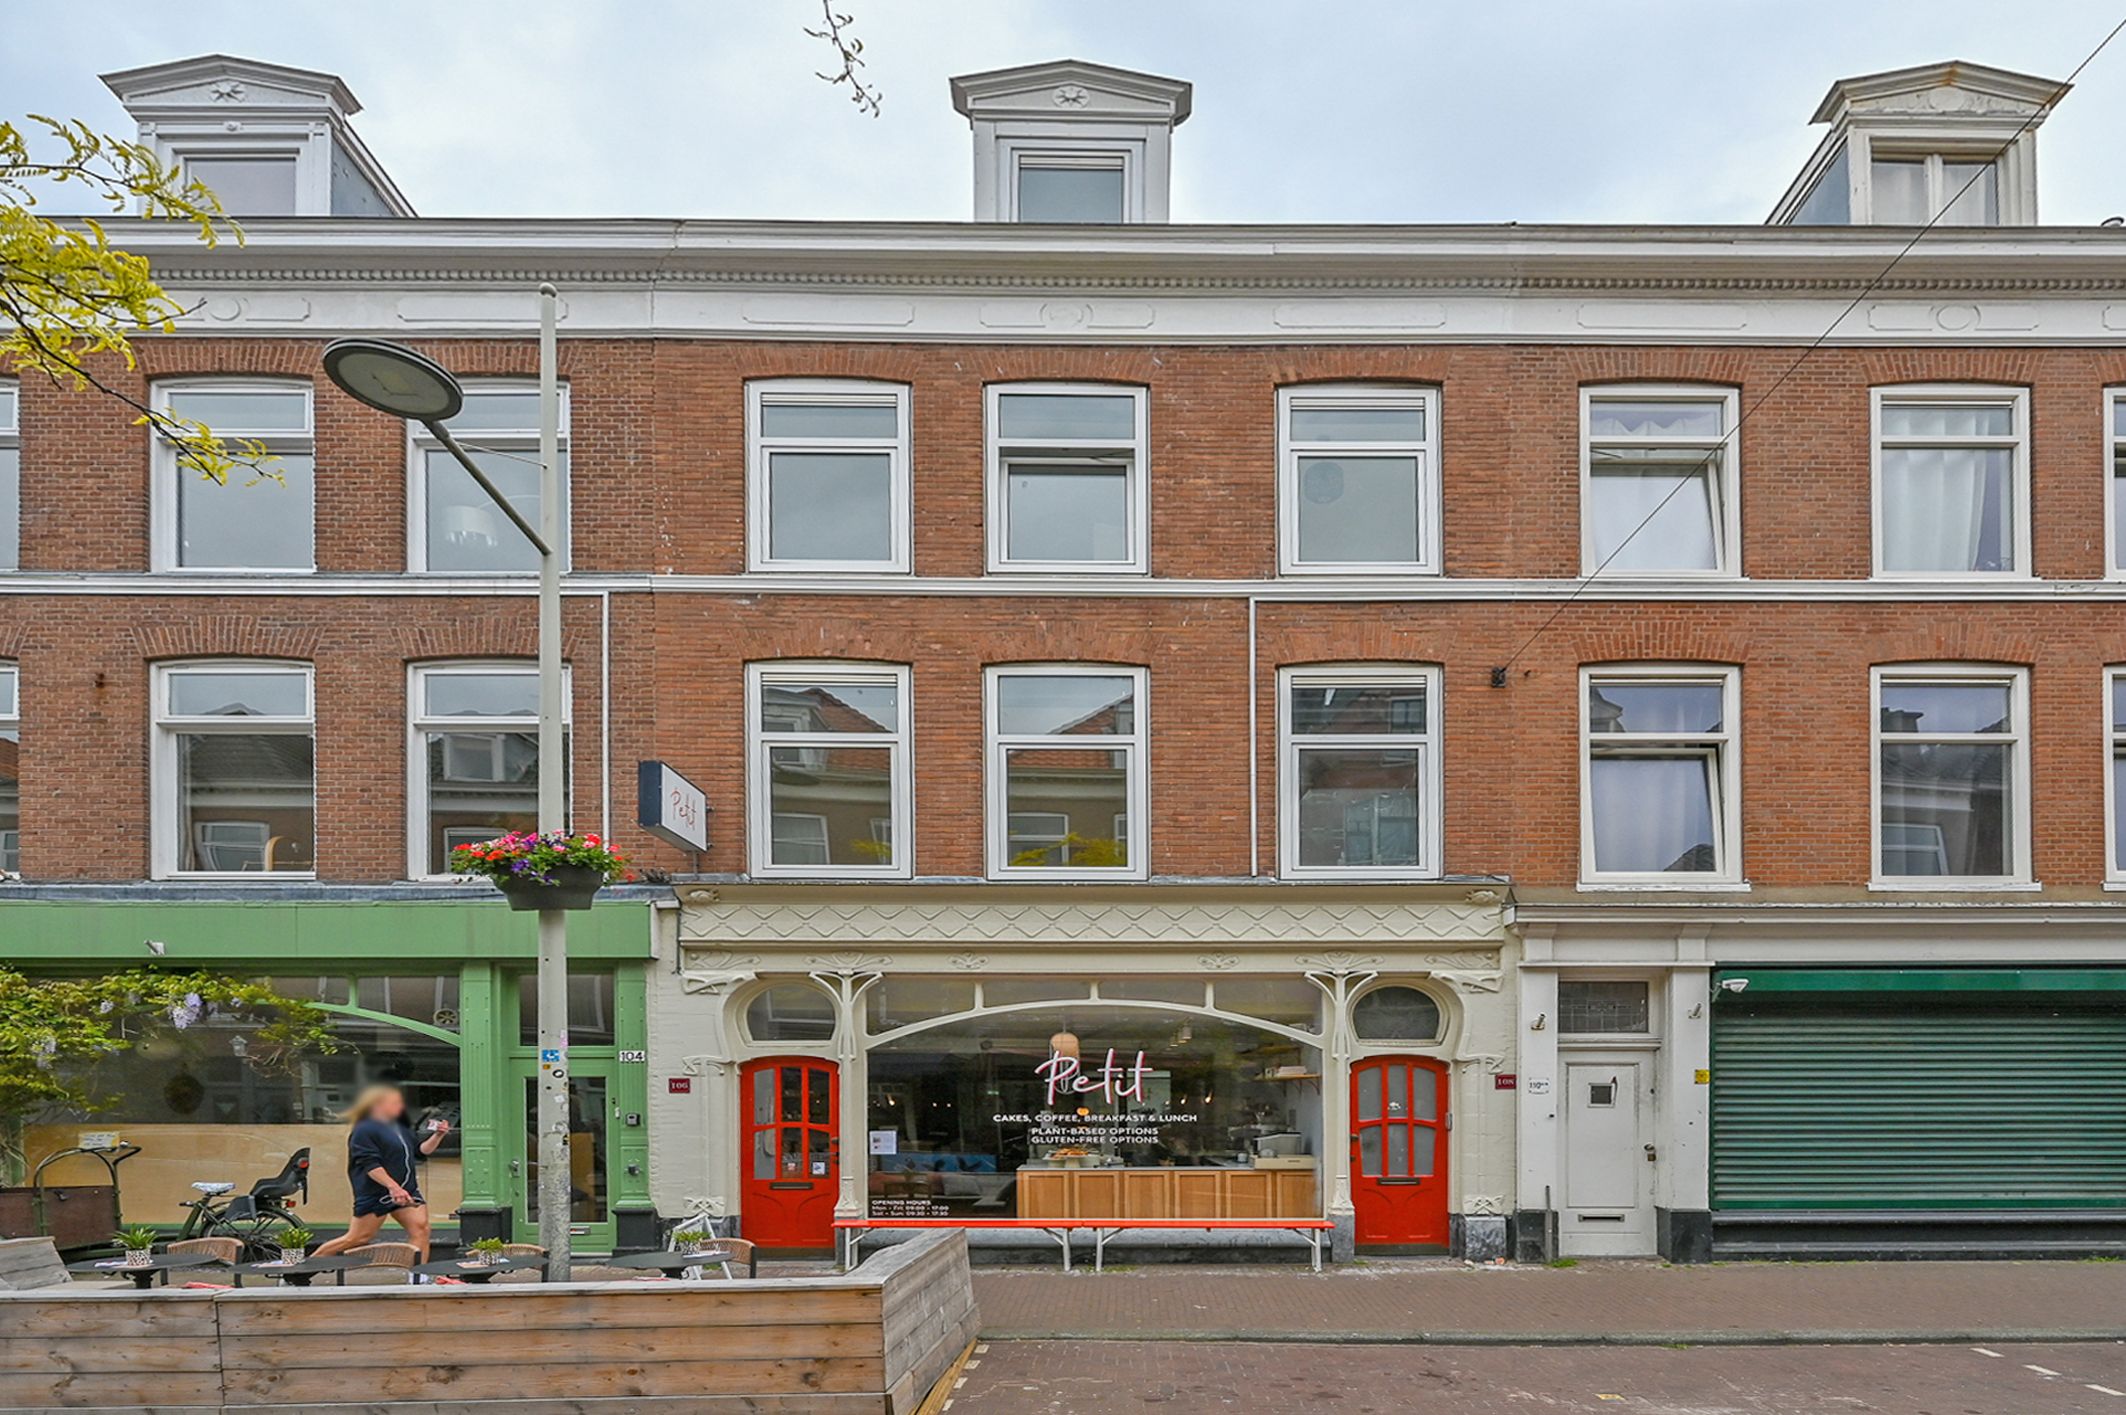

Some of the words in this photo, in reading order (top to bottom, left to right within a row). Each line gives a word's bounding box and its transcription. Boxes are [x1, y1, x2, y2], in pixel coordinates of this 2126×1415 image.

[621, 1052, 643, 1061] 104
[1034, 1048, 1155, 1105] Petit
[992, 1114, 1032, 1123] CAKES,
[1035, 1114, 1081, 1123] COFFEE,
[1084, 1114, 1146, 1122] BREAKFAST
[1148, 1114, 1156, 1122] &
[1159, 1114, 1197, 1122] LUNCH
[1031, 1127, 1106, 1135] PLANT-BASED
[1109, 1127, 1159, 1135] OPTIONS
